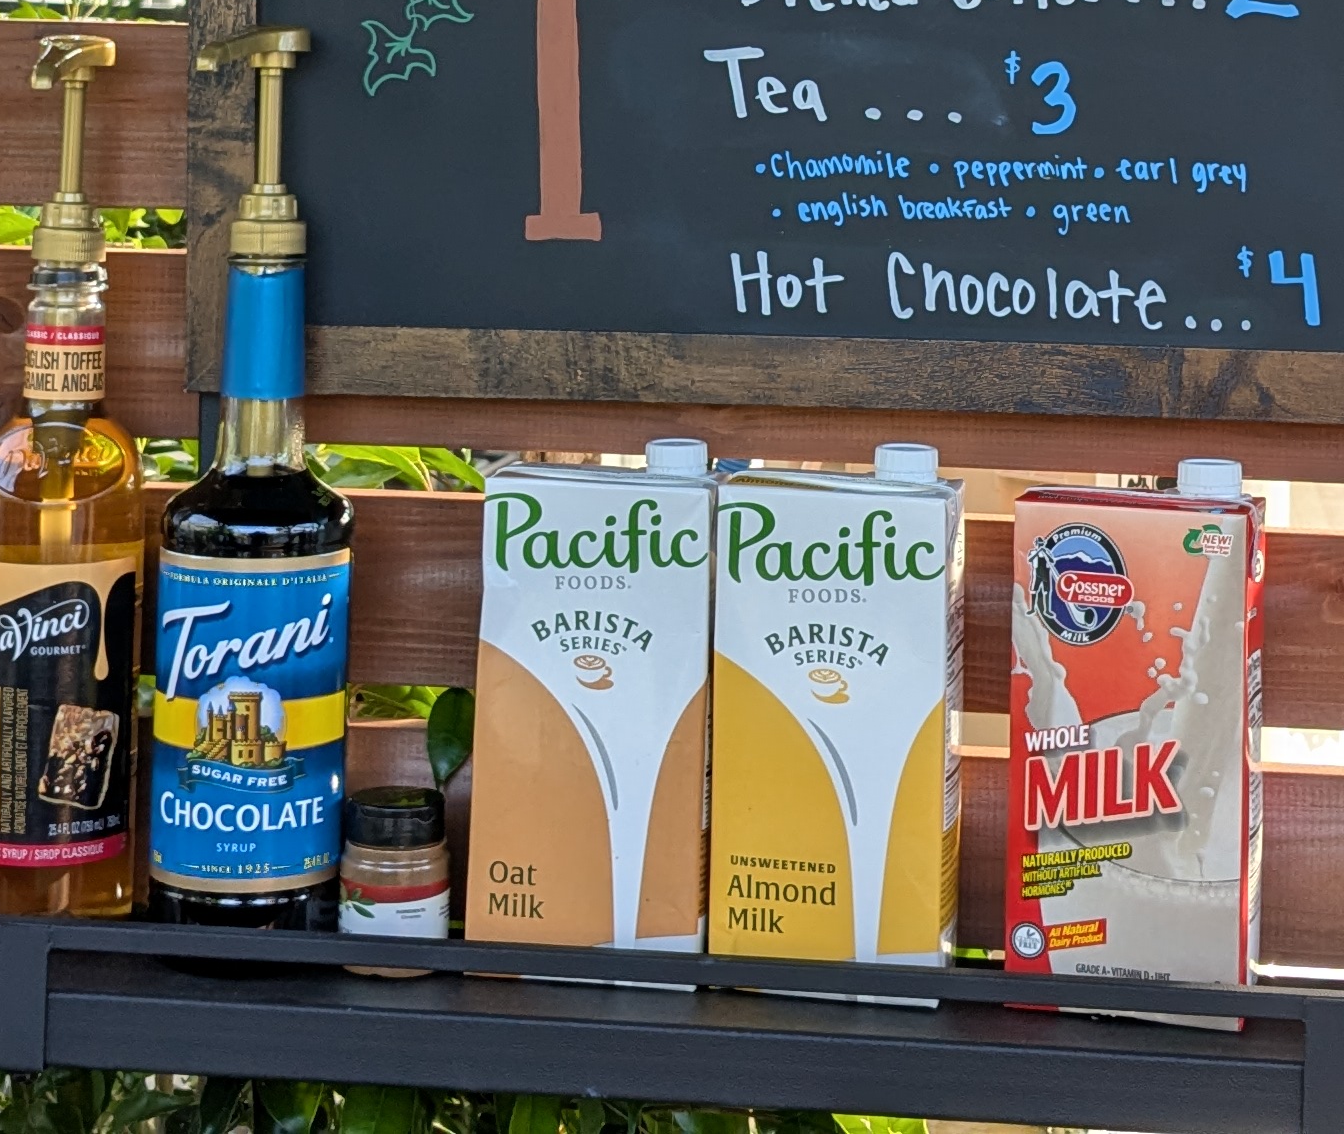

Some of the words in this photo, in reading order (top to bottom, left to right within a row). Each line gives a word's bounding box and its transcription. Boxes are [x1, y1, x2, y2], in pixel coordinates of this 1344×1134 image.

[703, 45, 827, 122] Tea
[1004, 50, 1078, 135] $3
[954, 154, 1089, 188] peppermint
[1115, 157, 1180, 185] earl
[1192, 160, 1249, 194] grey
[797, 194, 889, 228] english
[898, 194, 1013, 222] breakfast
[1052, 202, 1131, 236] green
[730, 250, 845, 317] Hot
[886, 251, 1168, 331] Chocolate
[1236, 246, 1321, 327] $4
[63, 351, 103, 371] TOFFEE
[485, 492, 708, 574] Pacific
[718, 501, 946, 587] Pacific
[1052, 525, 1103, 543] Premium
[1201, 533, 1233, 546] NEW!
[1060, 573, 1126, 604] Gossner
[1077, 594, 1115, 604] FOODS
[531, 609, 654, 653] BARISTA
[764, 622, 891, 667] BARISTA
[1060, 629, 1090, 642] Milk
[30, 645, 81, 656] GOURMET
[162, 592, 332, 702] Torani
[1025, 725, 1091, 752] WHOLE
[191, 764, 243, 786] SUGAR
[247, 774, 288, 787] FREE
[1025, 739, 1181, 829] MILK
[160, 791, 324, 833] CHOCOLATE
[216, 842, 256, 853] SYRUP
[1022, 850, 1076, 868] NATURALLY
[1078, 843, 1130, 862] PRODUCED
[488, 860, 538, 887] Oat
[730, 854, 837, 875] UNSWEETENED
[1022, 869, 1058, 883] WITHOUT
[727, 872, 837, 907] Almond
[488, 892, 545, 921] Milk
[727, 906, 785, 935] Milk
[1062, 921, 1099, 936] Natural
[1049, 937, 1070, 948] Dairy
[1072, 932, 1104, 944] Product
[1076, 963, 1099, 974] GRADE
